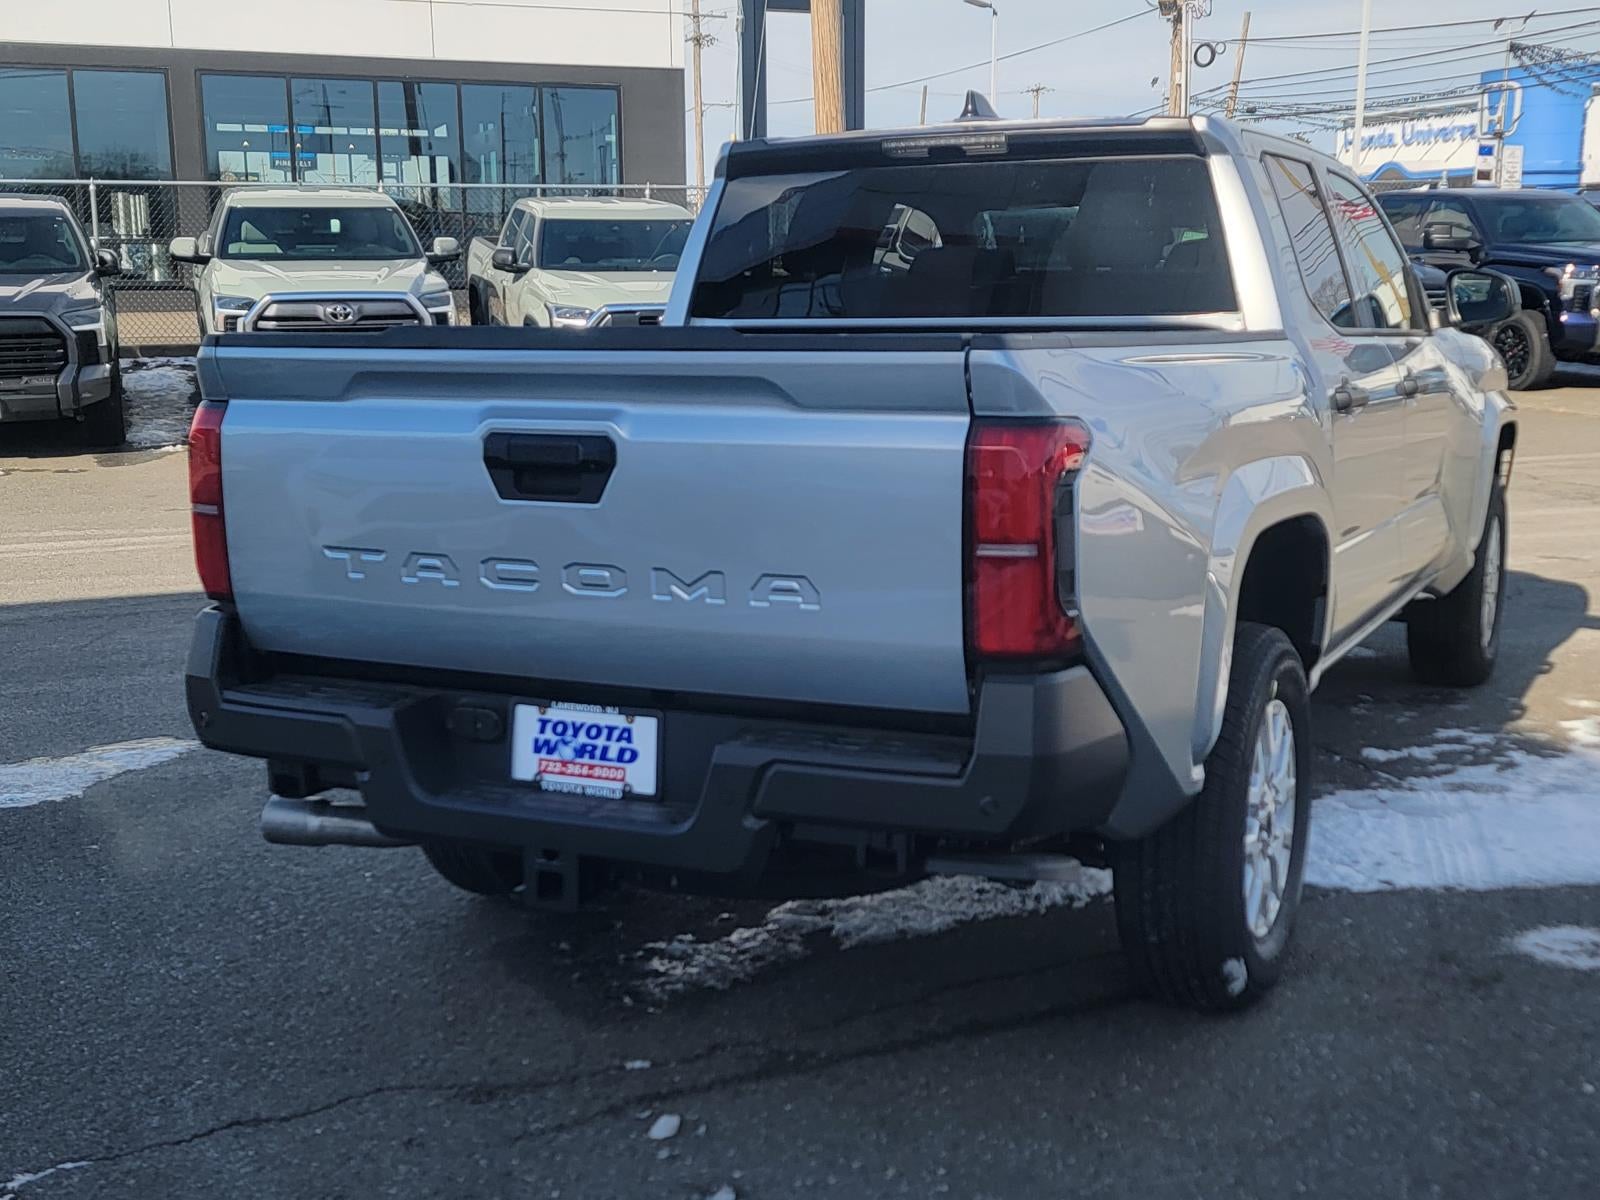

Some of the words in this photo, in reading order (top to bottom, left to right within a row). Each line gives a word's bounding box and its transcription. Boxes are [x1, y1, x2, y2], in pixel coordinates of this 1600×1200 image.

[322, 545, 821, 611] TACOMA
[537, 717, 633, 744] TOYOTA
[540, 781, 584, 795] TOYOTA
[585, 785, 623, 800] WORLD
